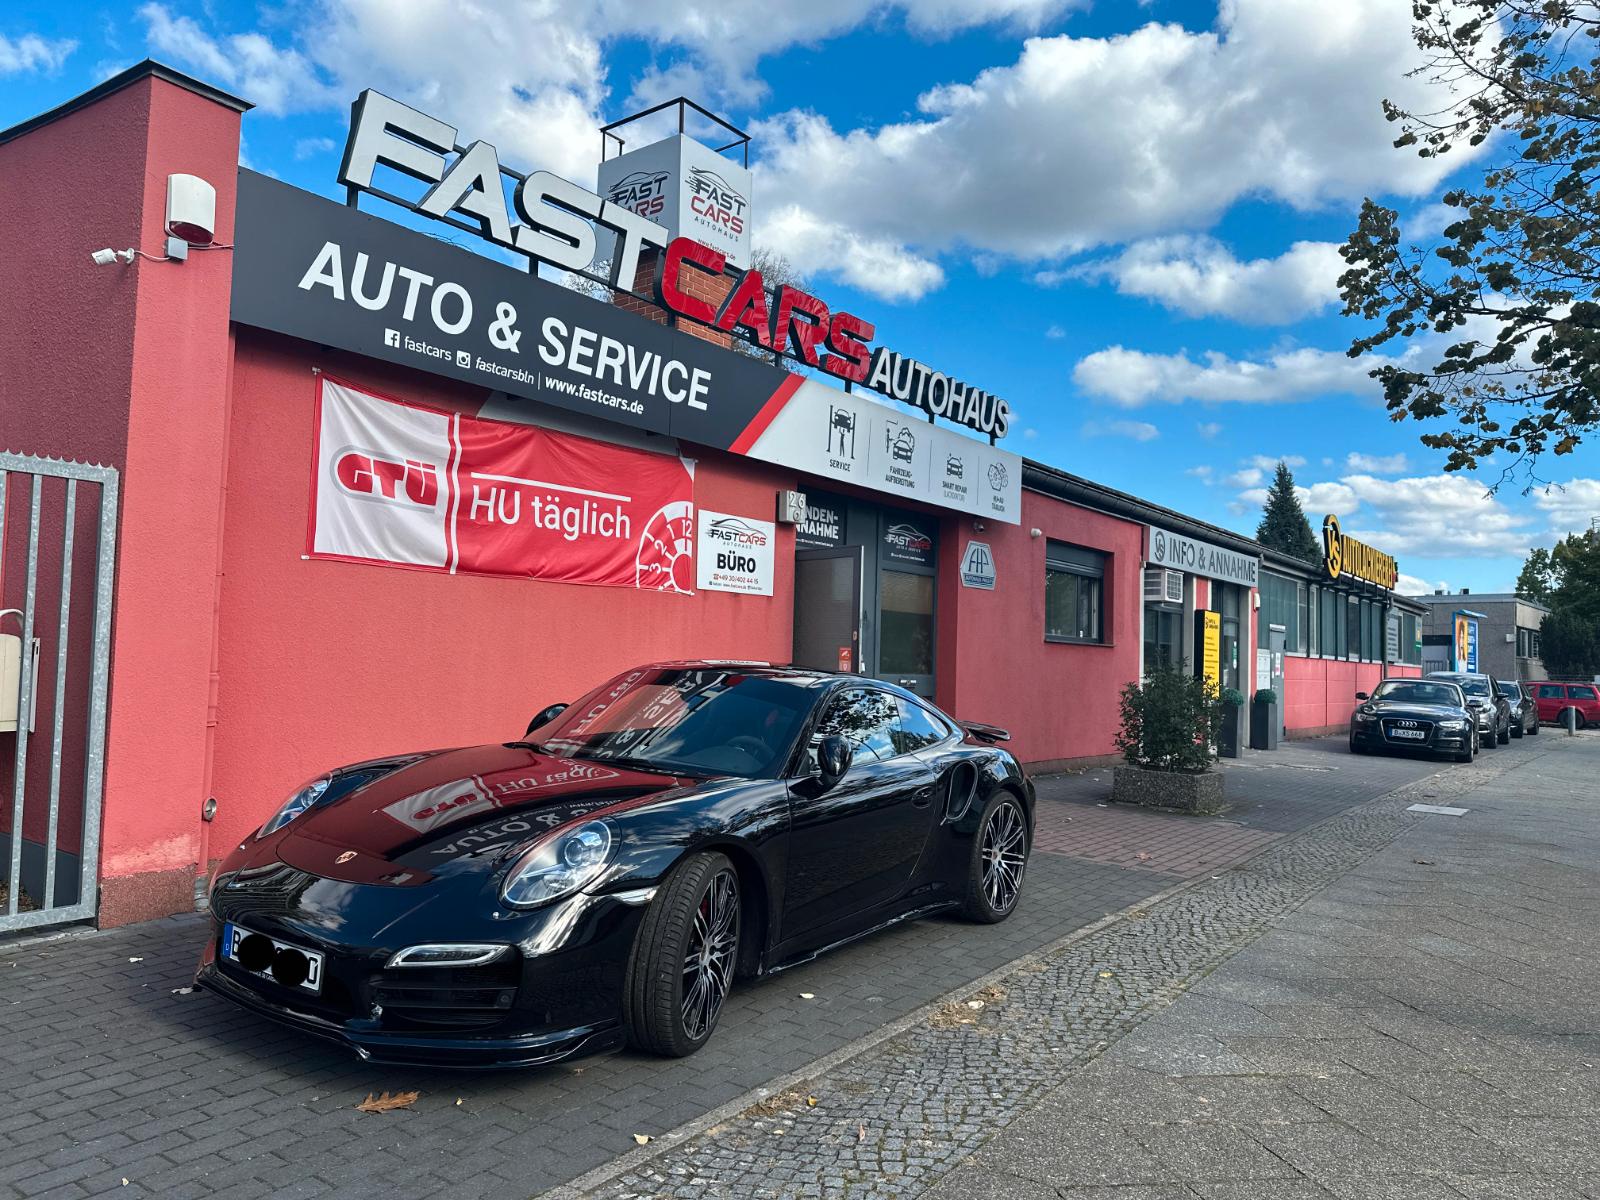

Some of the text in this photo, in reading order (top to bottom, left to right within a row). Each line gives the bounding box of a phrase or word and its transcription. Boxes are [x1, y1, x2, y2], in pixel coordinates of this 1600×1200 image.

[611, 176, 668, 205] FAST
[692, 176, 746, 215] FAST
[690, 195, 744, 235] CARS
[694, 216, 739, 242] AUTOHAUS
[339, 88, 1010, 438] FAST CARS AUTOHAUS
[298, 241, 712, 410] AUTO & SERVICE
[405, 336, 644, 415] fastcars fastcarsbln www.fastcars.de
[336, 450, 438, 506] GTÜ
[829, 459, 851, 472] SERVICE
[470, 485, 631, 541] HU täglich
[789, 491, 804, 509] 26
[682, 519, 692, 537] 12
[804, 505, 839, 524] NDEN-
[654, 540, 667, 556] 2
[709, 528, 767, 546] FASTCARS
[648, 562, 662, 574] 3
[716, 550, 756, 573] BÜRO
[1169, 537, 1195, 567] INFO
[1199, 547, 1206, 570] &
[1208, 550, 1256, 582] ANNAHME
